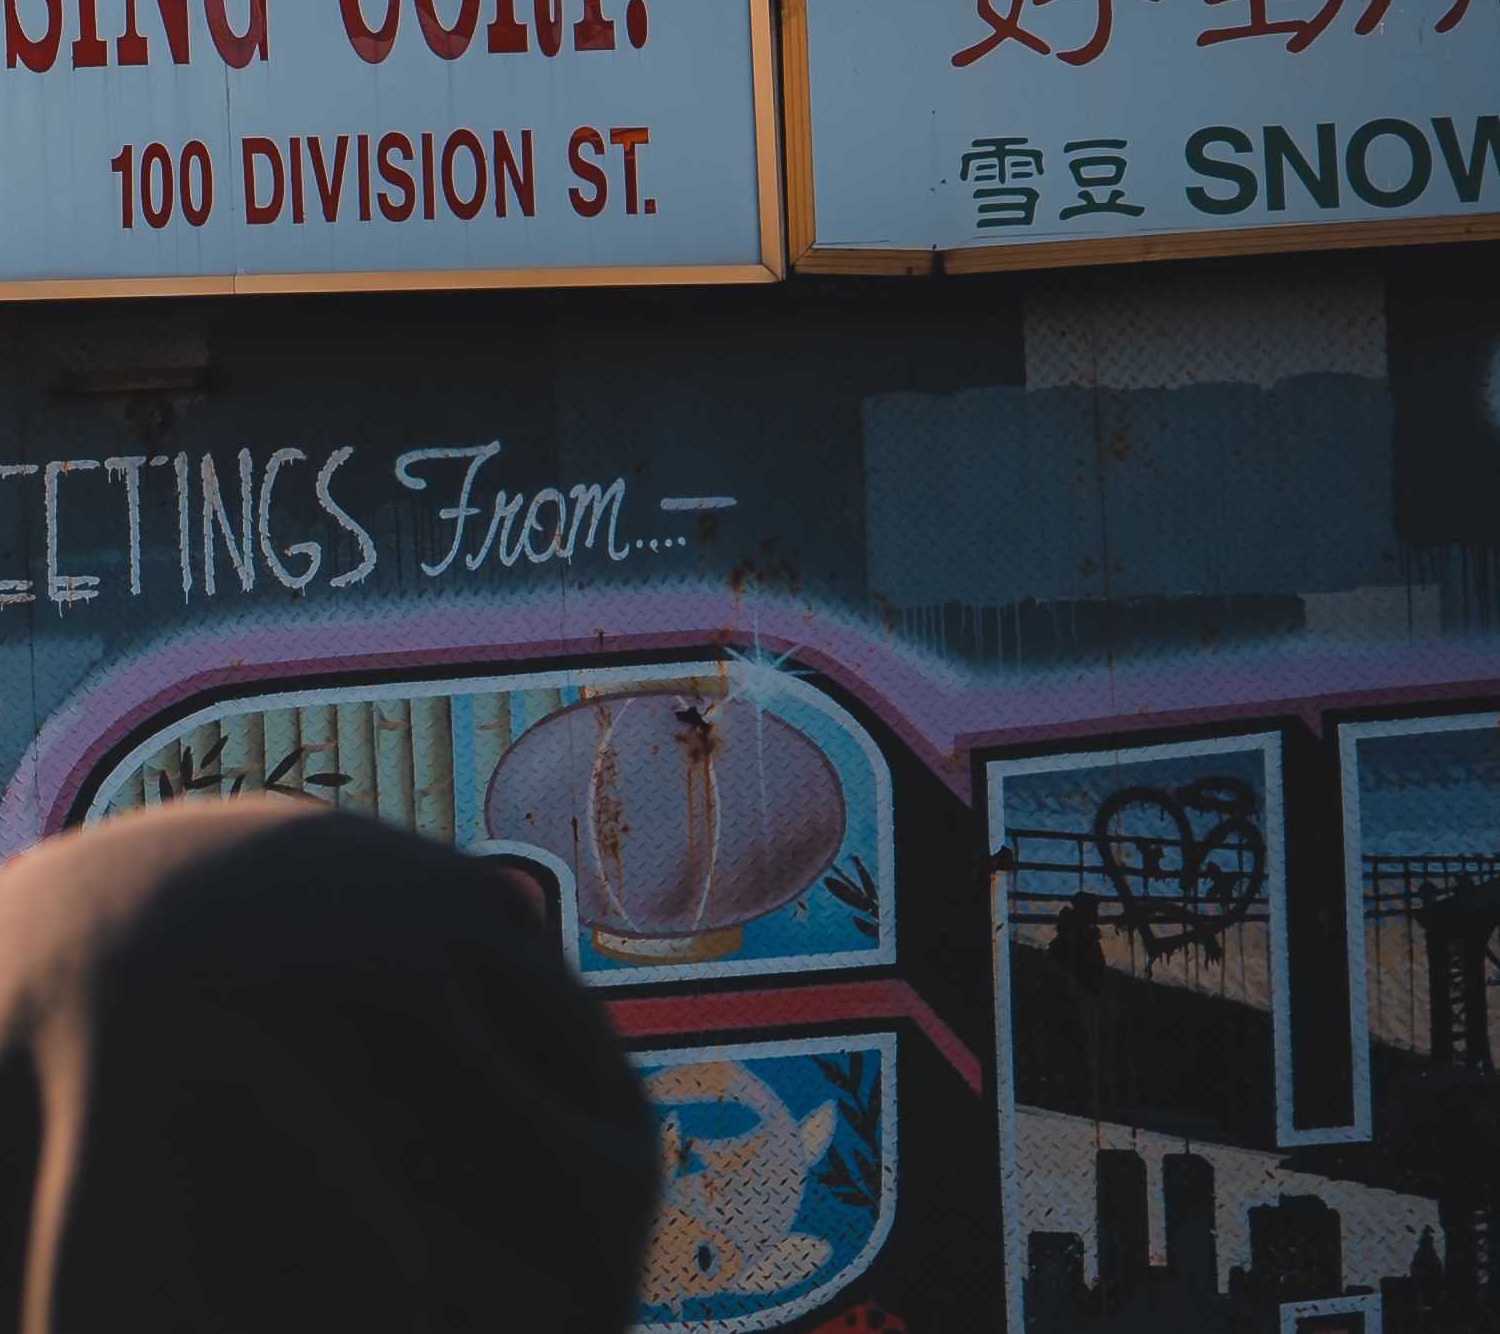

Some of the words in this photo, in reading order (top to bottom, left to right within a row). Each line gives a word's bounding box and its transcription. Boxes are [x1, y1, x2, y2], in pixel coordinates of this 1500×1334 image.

[110, 139, 214, 230] 100
[242, 128, 536, 227] DIVISION
[566, 126, 657, 218] ST.
[960, 136, 1146, 229] 雪豆
